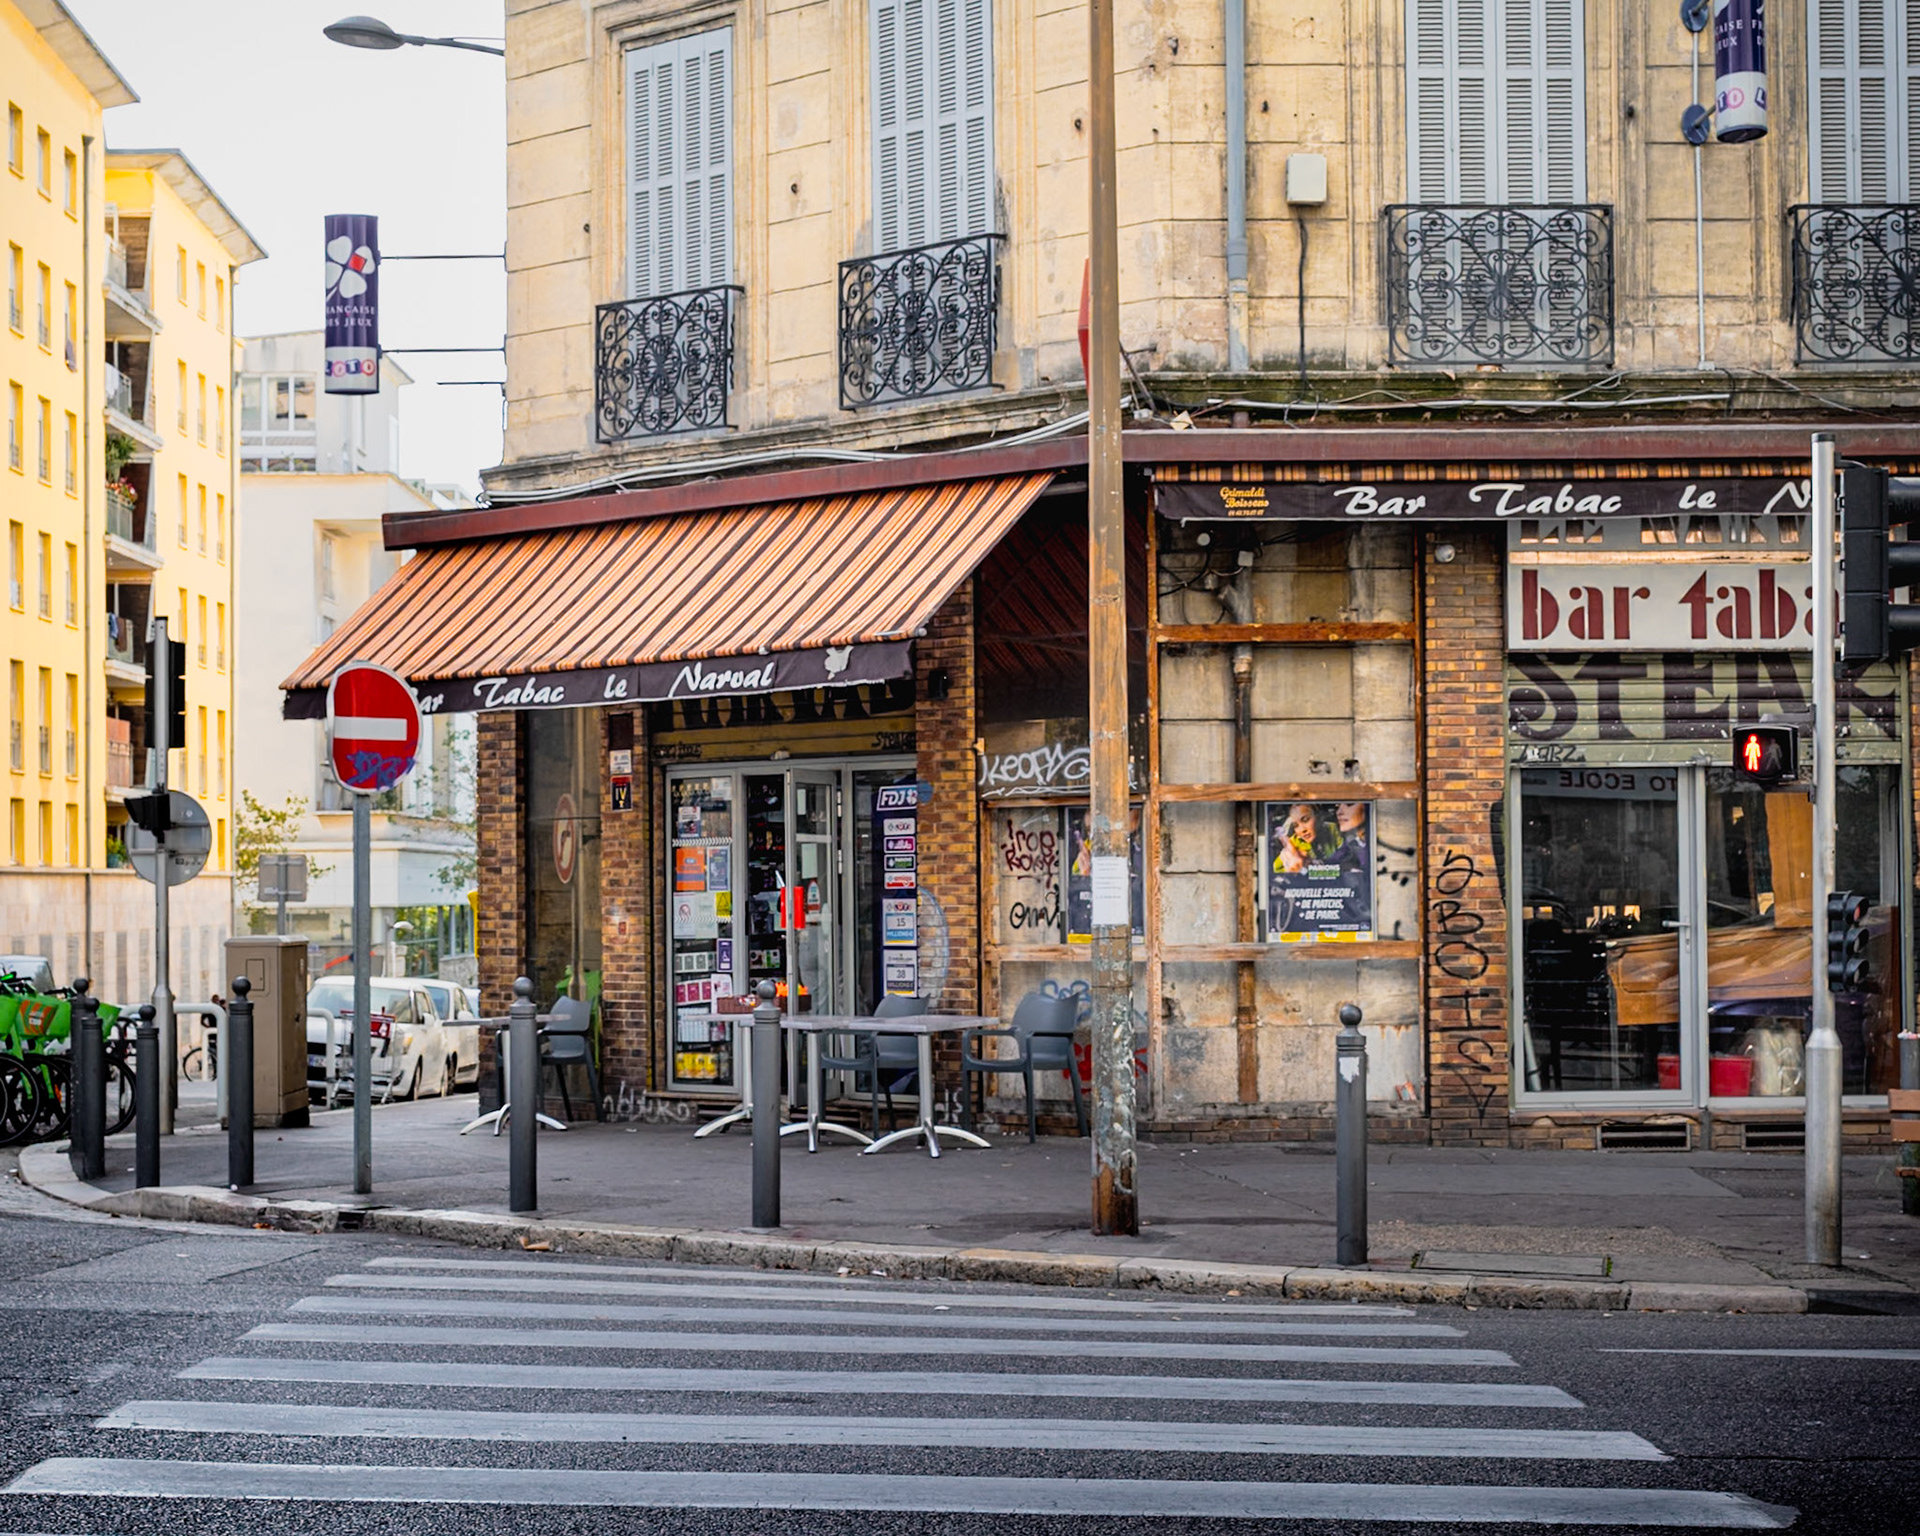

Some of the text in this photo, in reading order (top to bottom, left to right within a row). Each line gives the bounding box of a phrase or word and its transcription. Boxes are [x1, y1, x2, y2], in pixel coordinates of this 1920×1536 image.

[344, 318, 372, 327] JEUX
[1334, 482, 1718, 516] Bar Tabac le
[1521, 568, 1650, 641] bar
[411, 660, 776, 713] ar Tabac le Narval
[880, 790, 905, 806] FDJ
[1284, 887, 1322, 899] NOUVELLE
[1322, 887, 1351, 898] SAISON
[1301, 899, 1312, 909] DE
[1305, 910, 1316, 920] DE
